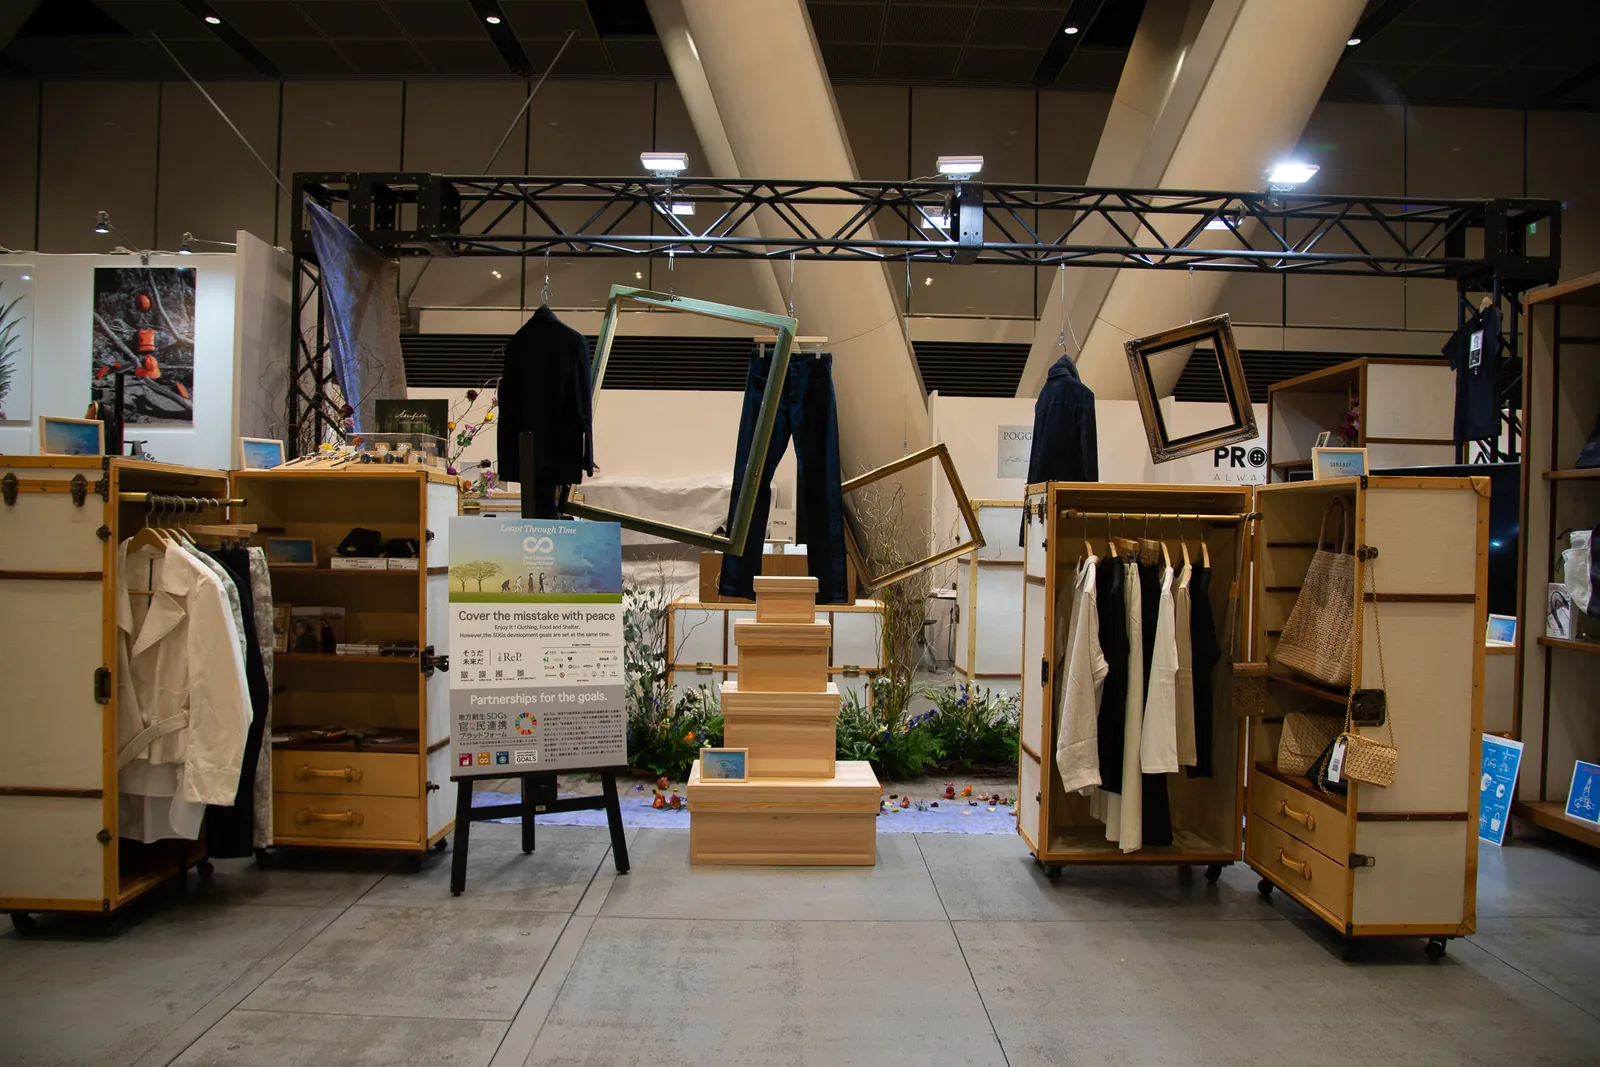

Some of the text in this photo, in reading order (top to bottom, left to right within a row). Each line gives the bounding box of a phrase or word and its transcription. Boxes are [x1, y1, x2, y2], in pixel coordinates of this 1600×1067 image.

[500, 524, 577, 535] Leapt Through Time
[458, 610, 615, 622] Cover the misstake with peace
[462, 649, 484, 657] そうだ
[470, 690, 608, 706] Partnerships for the goals.
[458, 712, 508, 721] 地方創生 SDGs
[459, 731, 508, 739] プラットフォーム
